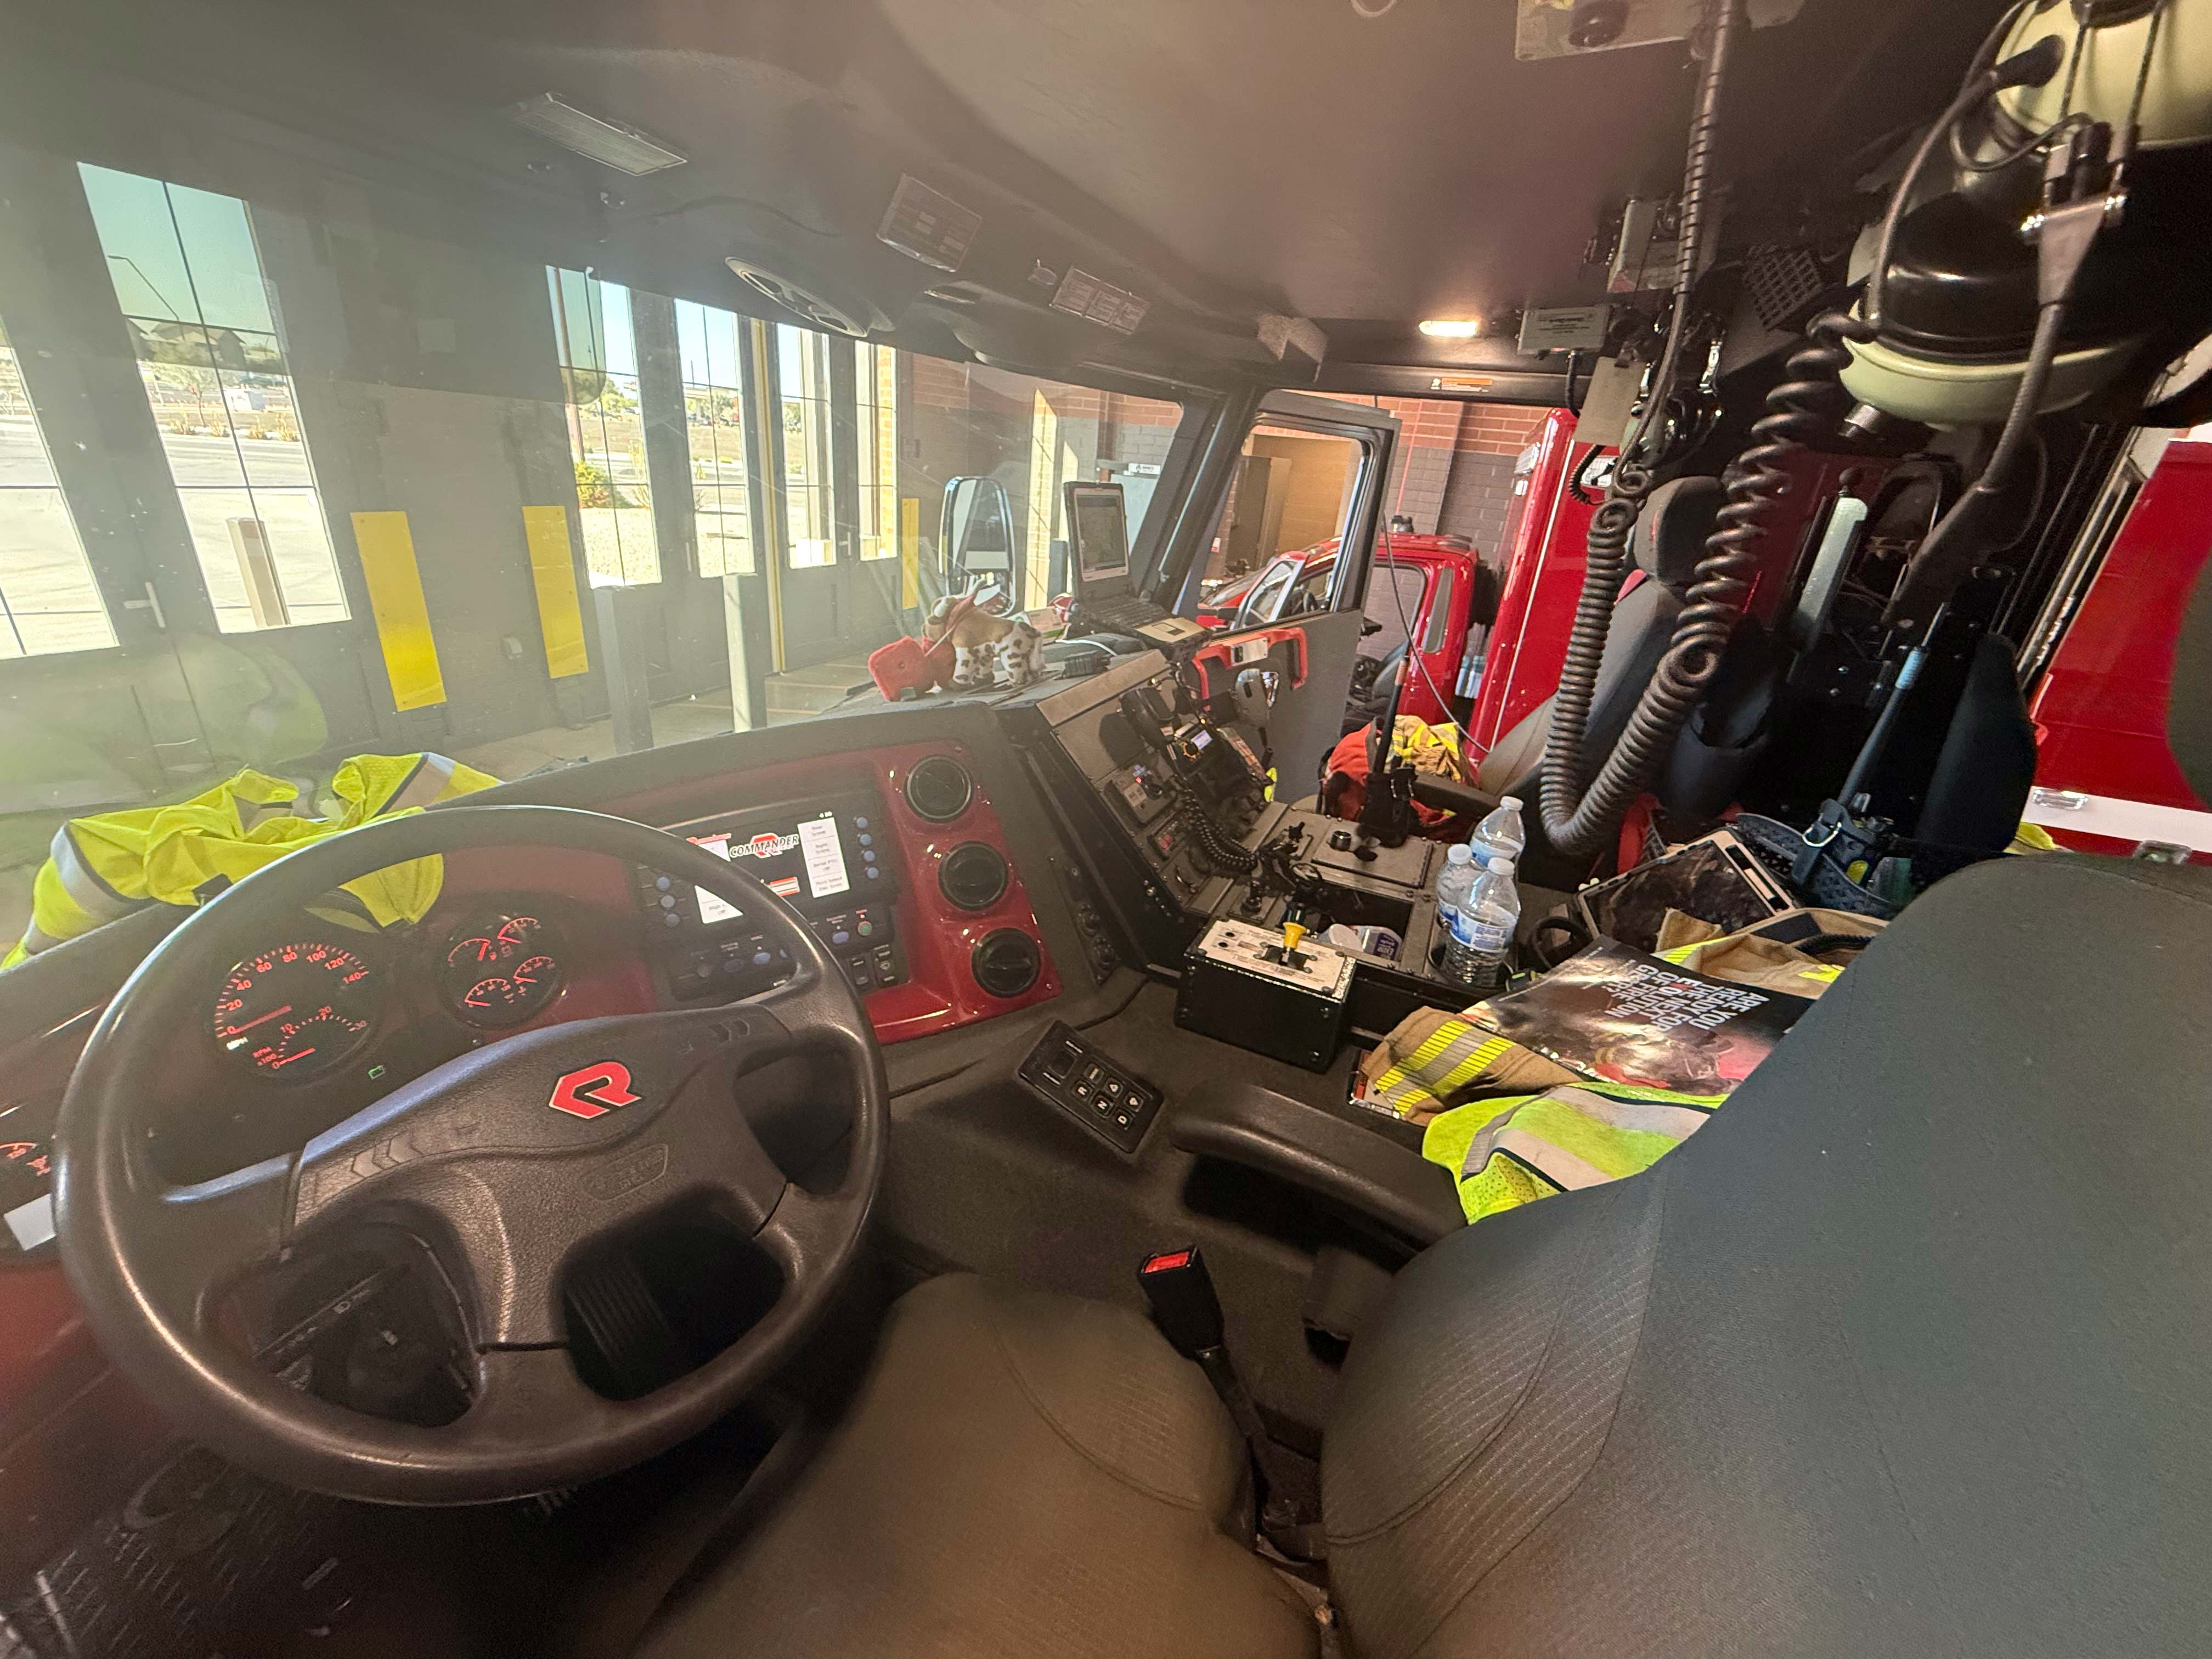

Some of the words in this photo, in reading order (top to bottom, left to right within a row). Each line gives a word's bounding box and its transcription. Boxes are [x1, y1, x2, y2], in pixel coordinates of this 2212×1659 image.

[730, 836, 798, 856] COMMANDER
[283, 951, 297, 962] 80
[306, 950, 326, 963] 100
[256, 962, 272, 973] 60
[325, 957, 345, 970] 120
[343, 972, 362, 984] 140
[1650, 972, 1679, 985] OF
[236, 980, 252, 990] 40
[1604, 977, 1703, 1018] EVOLUTION
[1611, 983, 1658, 1001] FIRE
[1679, 984, 1725, 1000] THE
[226, 999, 242, 1011] 20
[1638, 997, 1691, 1019] NEXT
[1683, 988, 1748, 1015] READY
[1722, 992, 1770, 1013] ARE
[1650, 1012, 1693, 1031] FOR
[1689, 1009, 1739, 1030] YOU
[227, 1026, 236, 1034] 0
[252, 1046, 272, 1058] RPM
[272, 1061, 280, 1069] 0
[1078, 1087, 1087, 1095] R
[1098, 1101, 1107, 1109] N
[1118, 1115, 1127, 1124] D
